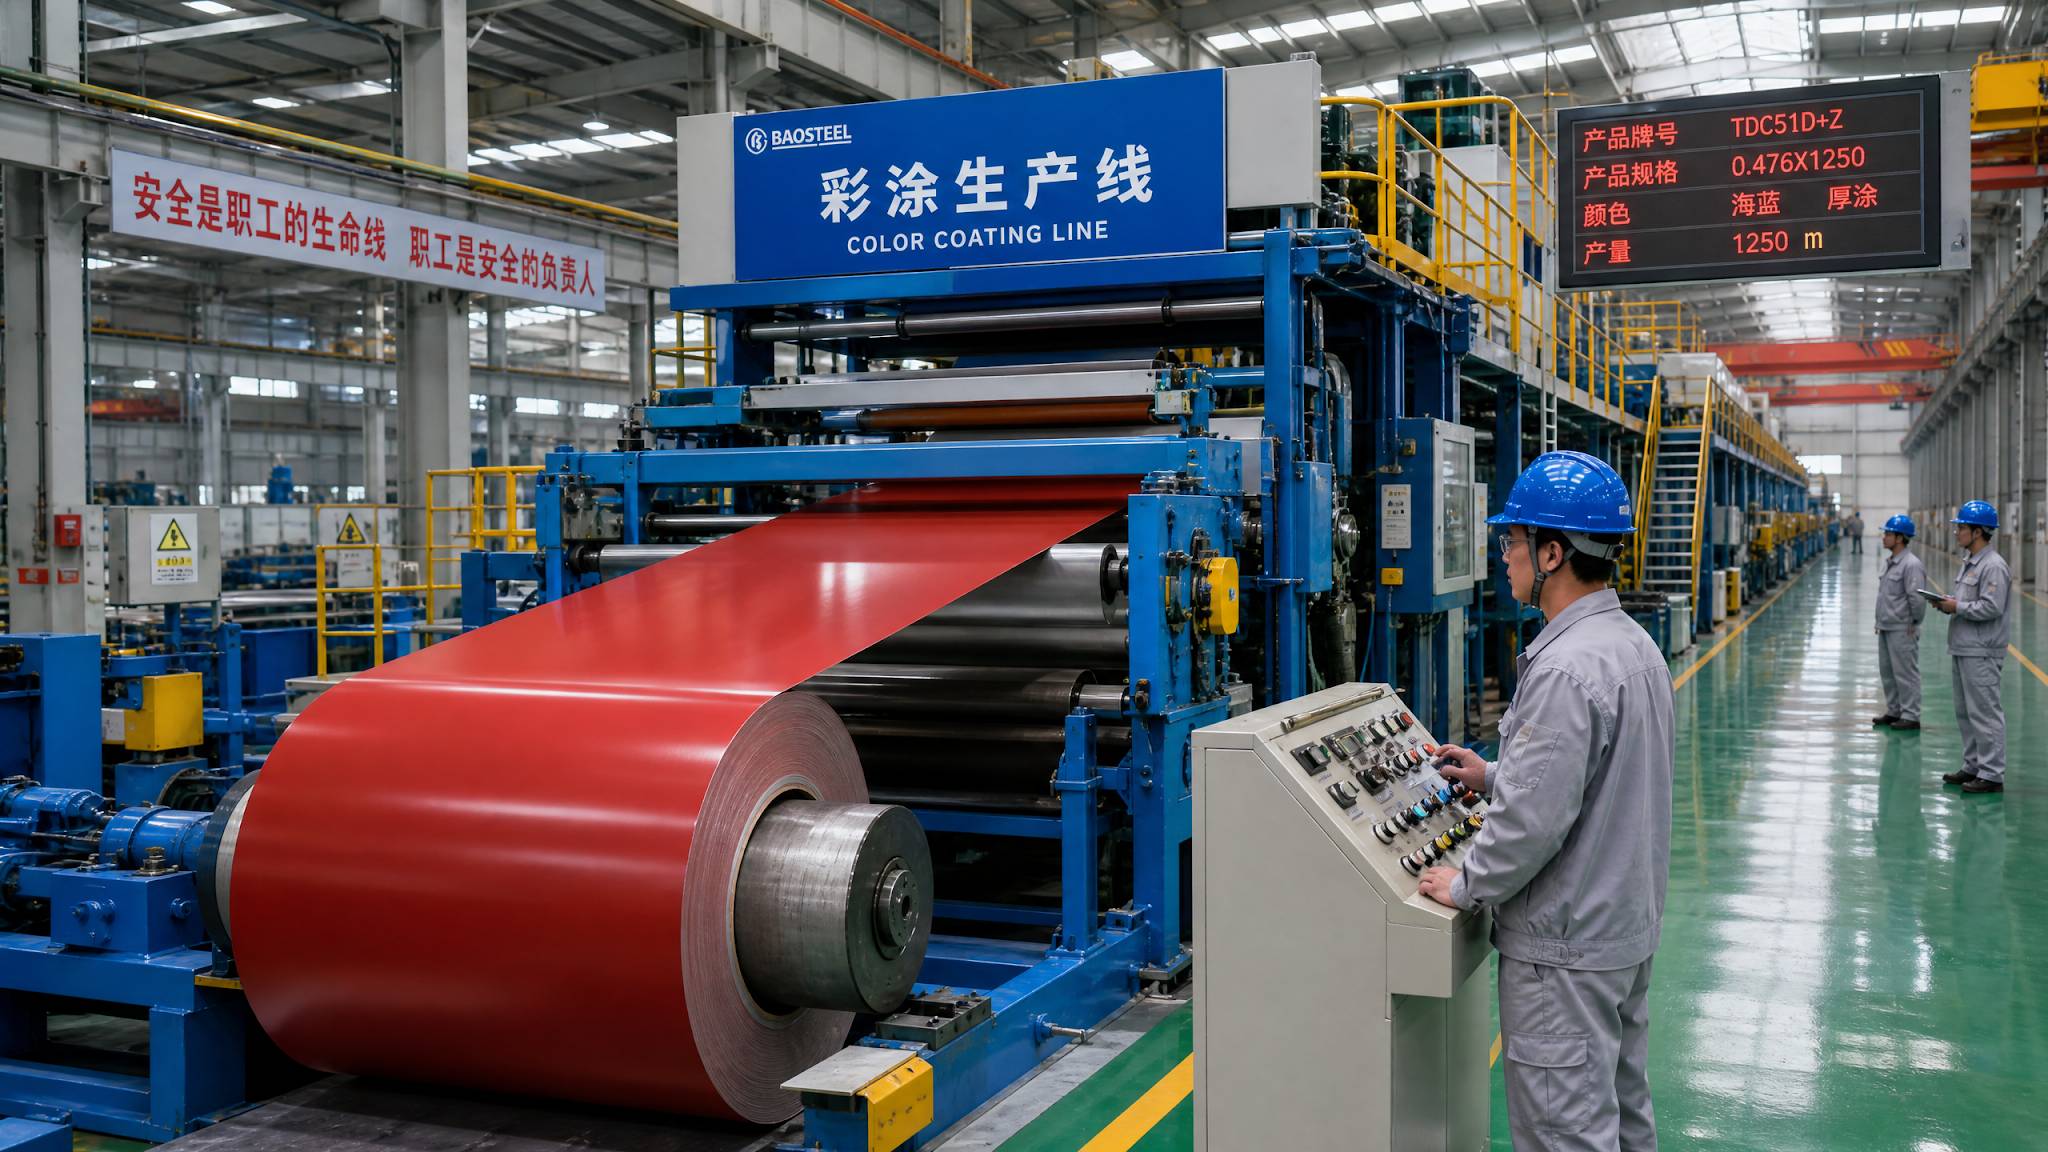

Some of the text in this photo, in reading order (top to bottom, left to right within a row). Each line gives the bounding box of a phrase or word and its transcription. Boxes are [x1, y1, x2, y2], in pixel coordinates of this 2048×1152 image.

[771, 124, 852, 145] BAOSTEEL
[1583, 121, 1679, 153] 产品牌号
[1730, 108, 1844, 138] TDC51D+Z
[1583, 160, 1680, 191] 产品规格
[1731, 145, 1866, 177] 0.476X1250
[820, 144, 1153, 223] 彩涂生产线
[1583, 202, 1631, 229] 颜色
[1731, 182, 1879, 218] 海蓝 厚涂
[133, 172, 596, 297] 安全是职工的生命线 职工是安全的负责人
[847, 220, 1108, 254] COLOR COATING LINE
[1732, 230, 1823, 255] 1250 m
[1583, 239, 1632, 266] 产量
